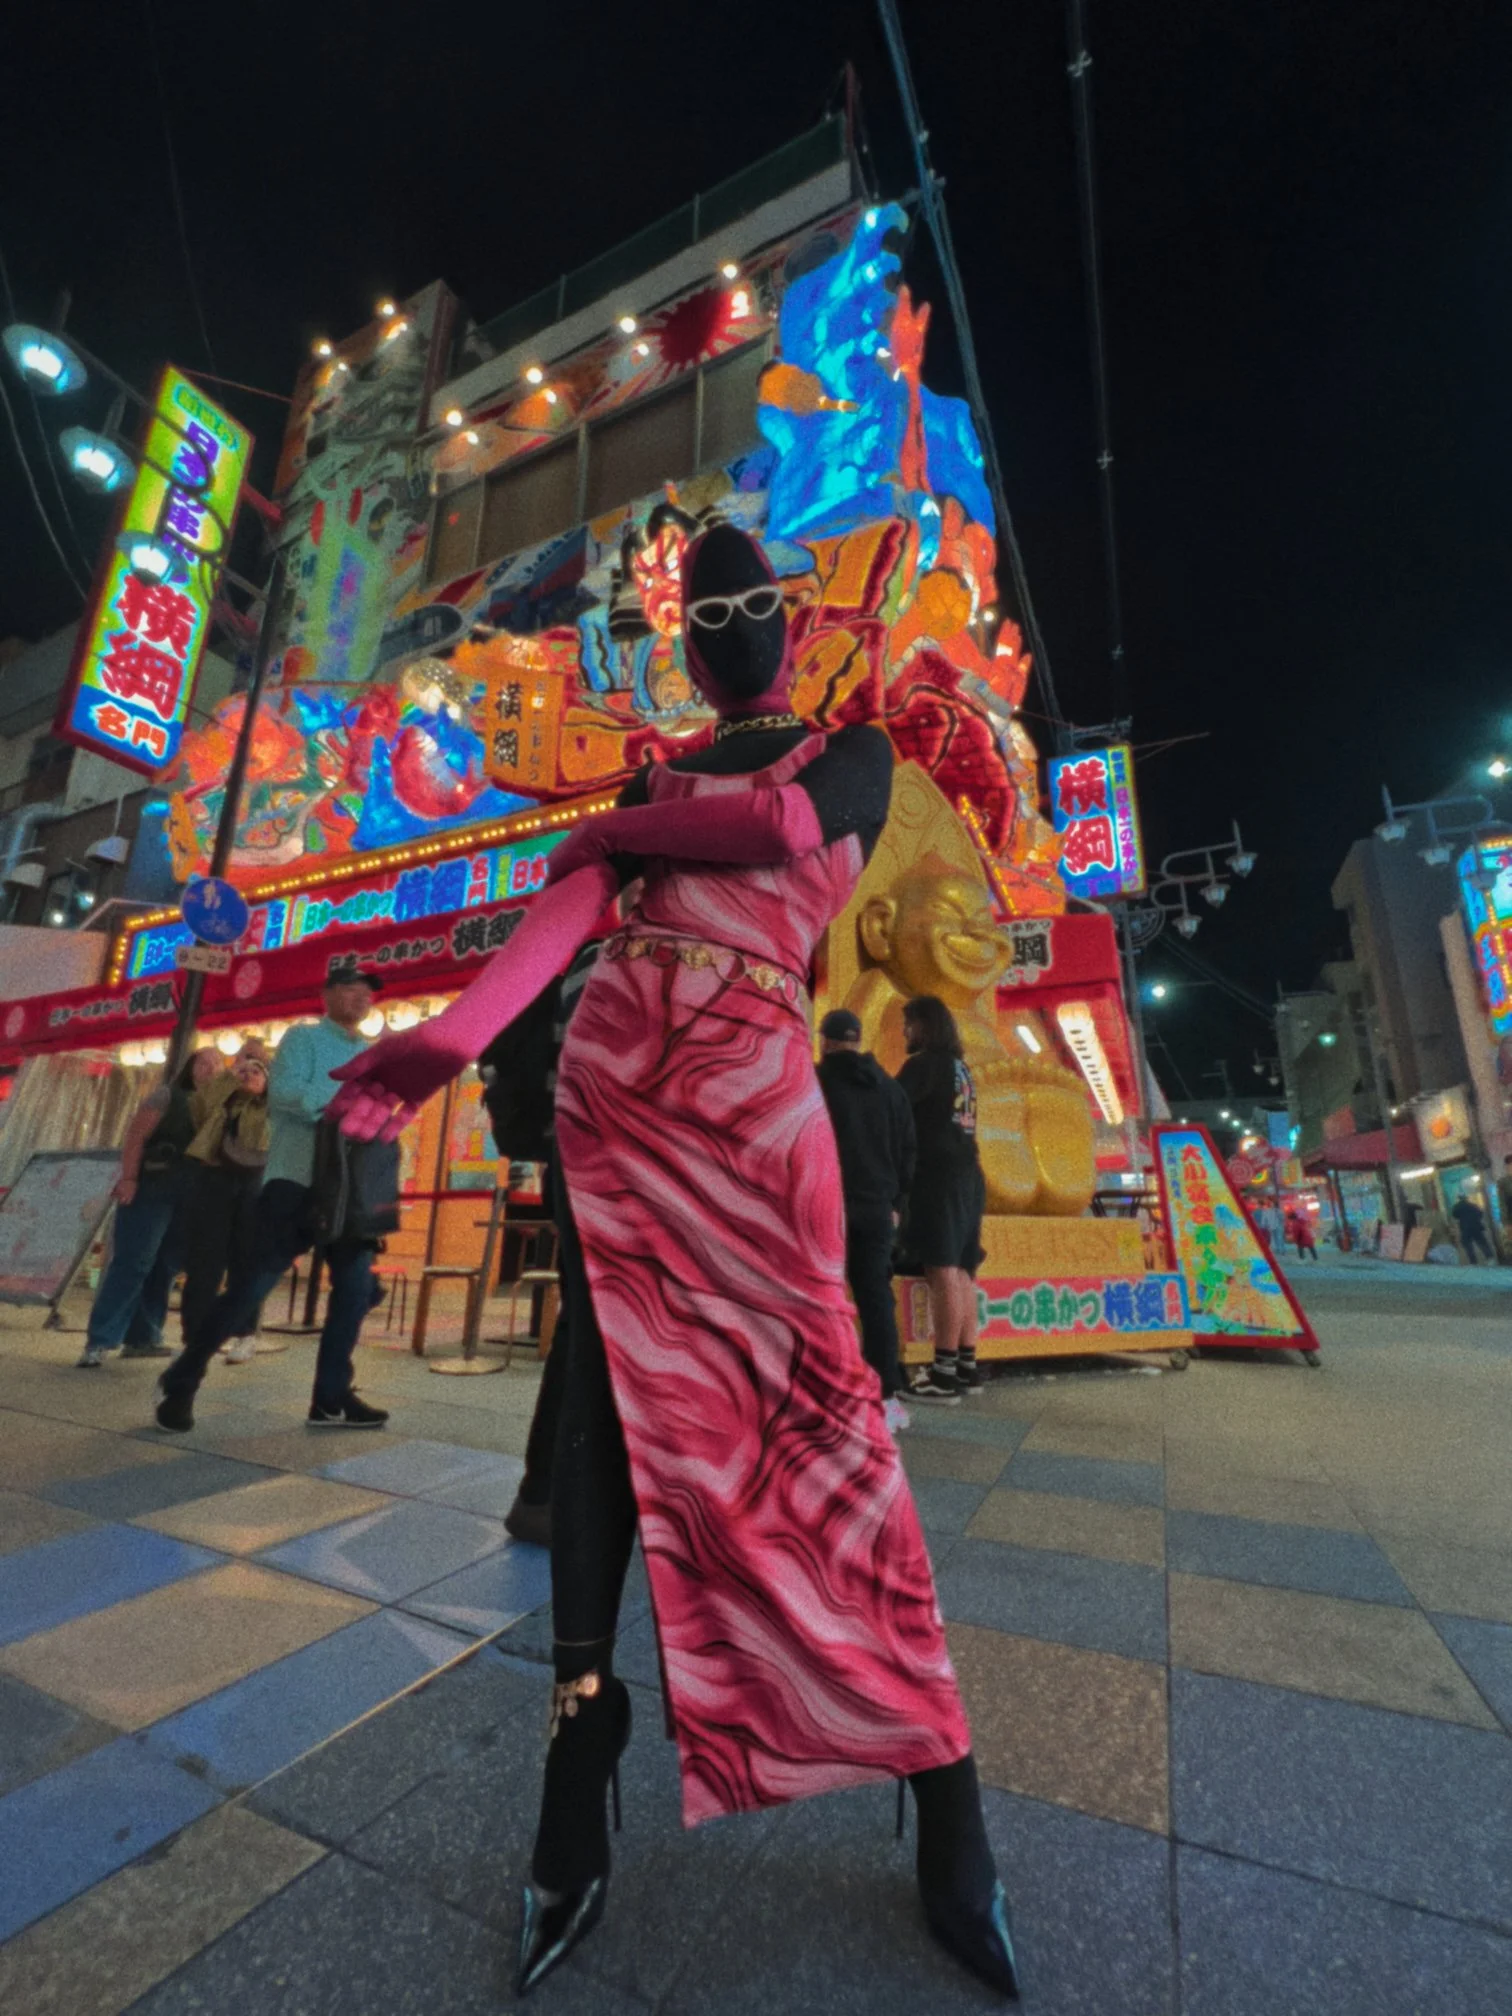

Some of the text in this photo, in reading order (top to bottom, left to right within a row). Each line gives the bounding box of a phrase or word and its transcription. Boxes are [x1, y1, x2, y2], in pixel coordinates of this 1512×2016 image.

[103, 575, 197, 722] 横綱
[95, 703, 167, 757] 名門
[1057, 758, 1115, 875] 横綱
[1102, 1279, 1165, 1327] 横綱
